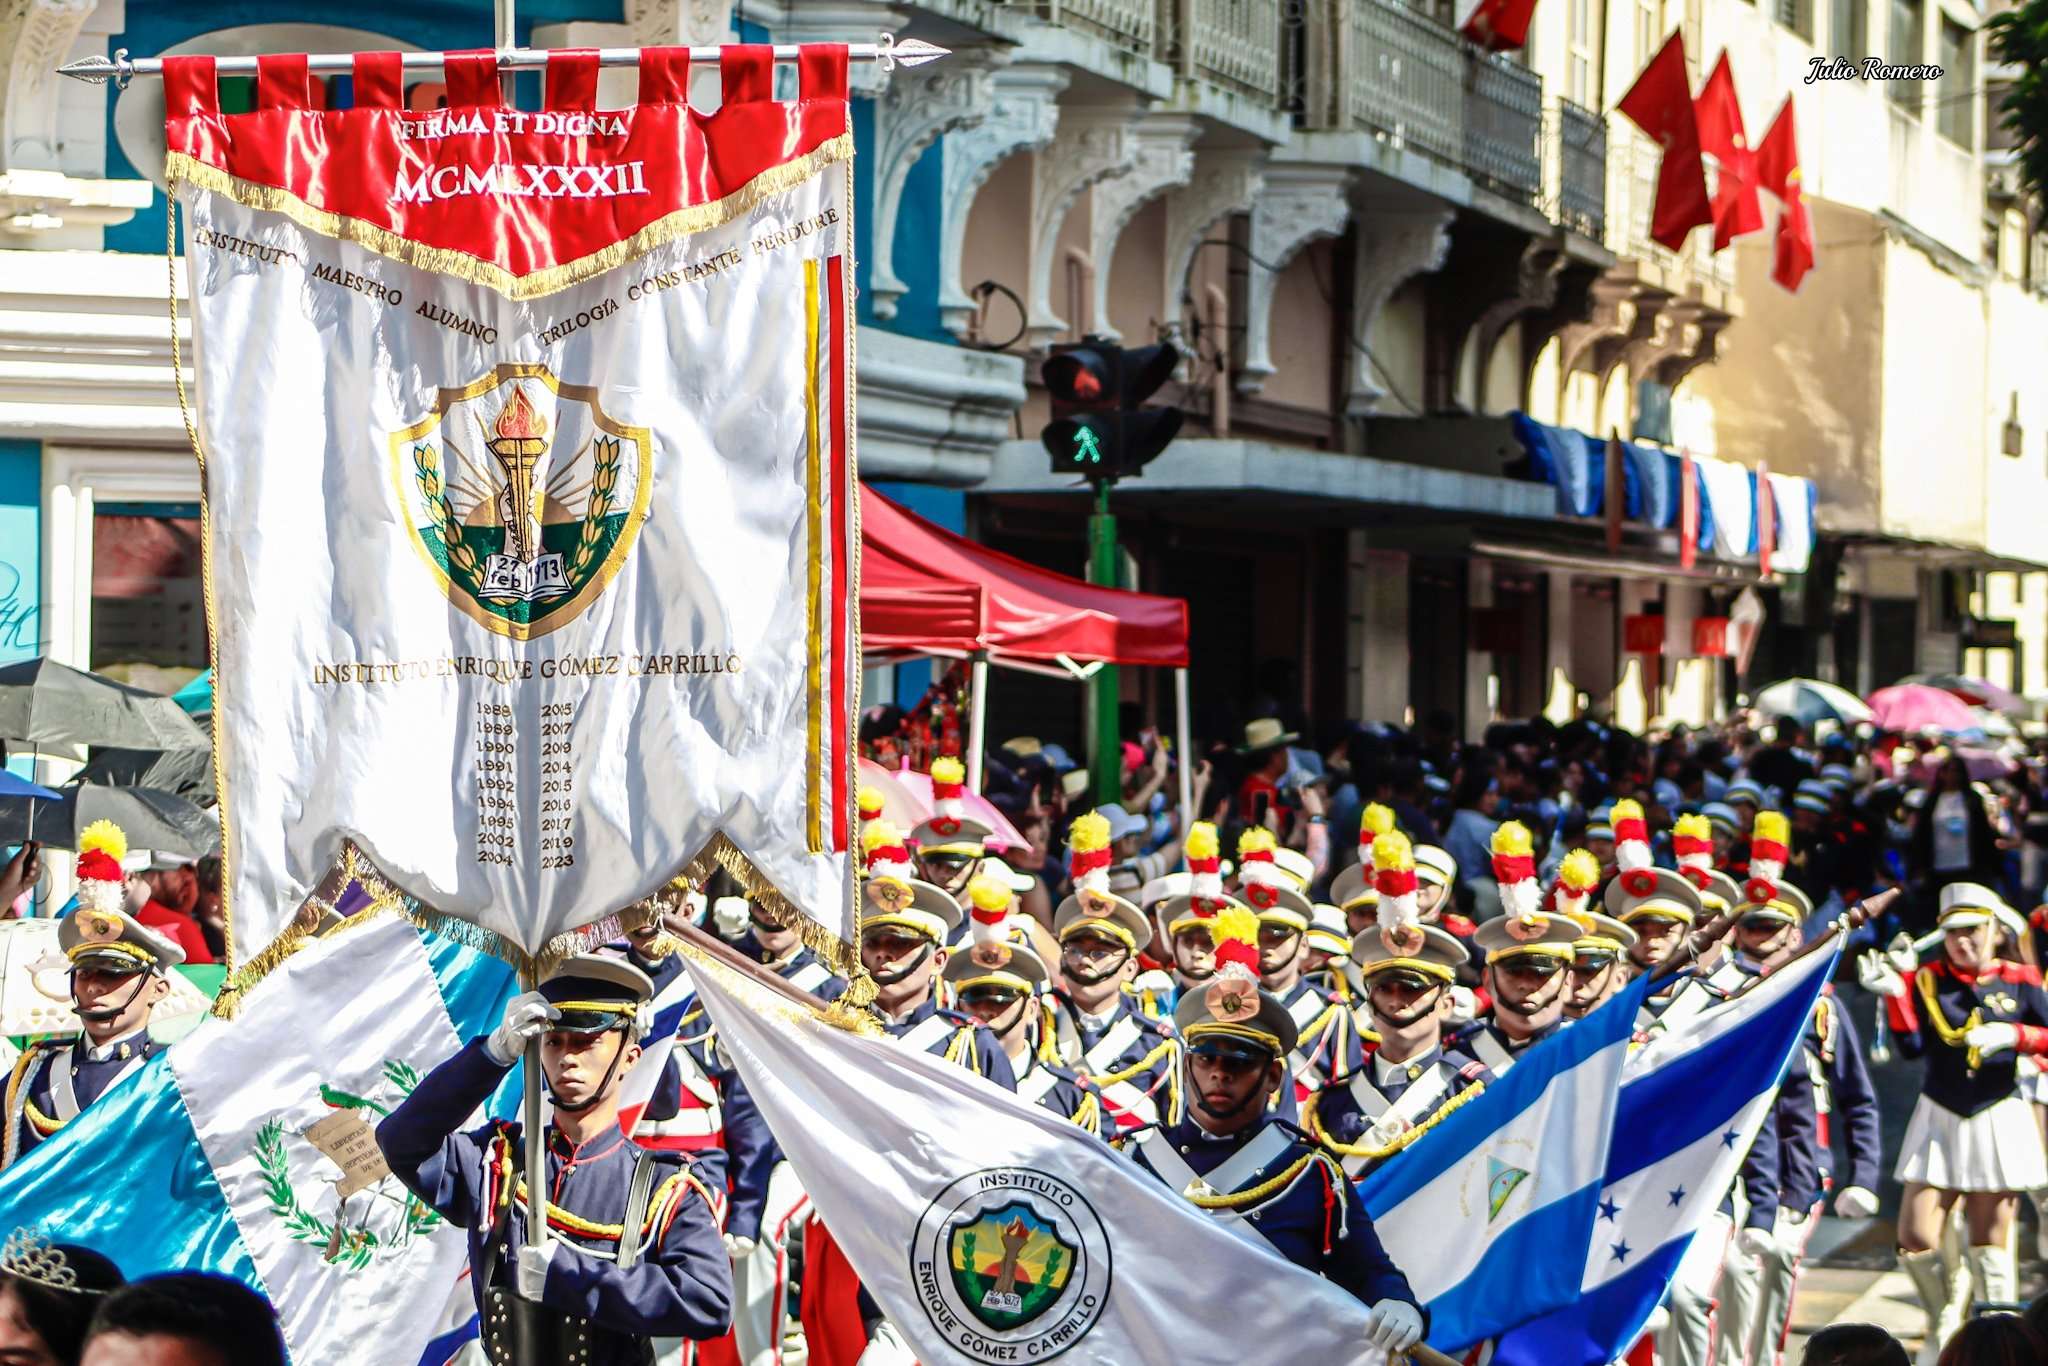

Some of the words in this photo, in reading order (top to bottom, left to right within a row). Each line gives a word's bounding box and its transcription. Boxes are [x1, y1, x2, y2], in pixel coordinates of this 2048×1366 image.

[401, 112, 489, 140] FIRMA
[494, 112, 529, 134] ET
[534, 112, 627, 136] DIGNA
[391, 161, 648, 202] MCMLXXXII
[193, 227, 298, 266] INSTITUTO
[312, 263, 402, 305] MAESTRO
[416, 301, 498, 344] ALUMNO
[538, 298, 620, 347] TRILOGÍA
[627, 248, 742, 302] CONSTANTE
[751, 208, 840, 256] PERDURE
[497, 557, 520, 572] 27
[528, 558, 560, 586] 1973
[491, 571, 521, 589] feb
[436, 656, 533, 685] ENRIQUE
[540, 653, 619, 679] GÓMEZ
[628, 654, 741, 677] CARRILLO
[477, 721, 513, 736] 1989
[476, 740, 514, 754] 1990
[476, 759, 513, 774] 1991
[476, 778, 515, 794] 1992
[478, 796, 515, 812] 1994
[479, 815, 514, 830] 1995
[542, 818, 572, 832] 2017
[478, 832, 514, 848] 2002
[542, 836, 573, 850] 2019
[478, 850, 513, 867] 2004
[542, 854, 574, 870] 2023
[980, 1173, 1073, 1207] INSTITUTO
[919, 1261, 957, 1332] ENRIQUE
[960, 1333, 1017, 1360] GÓMEZ
[1028, 1294, 1097, 1356] CARRILLO
